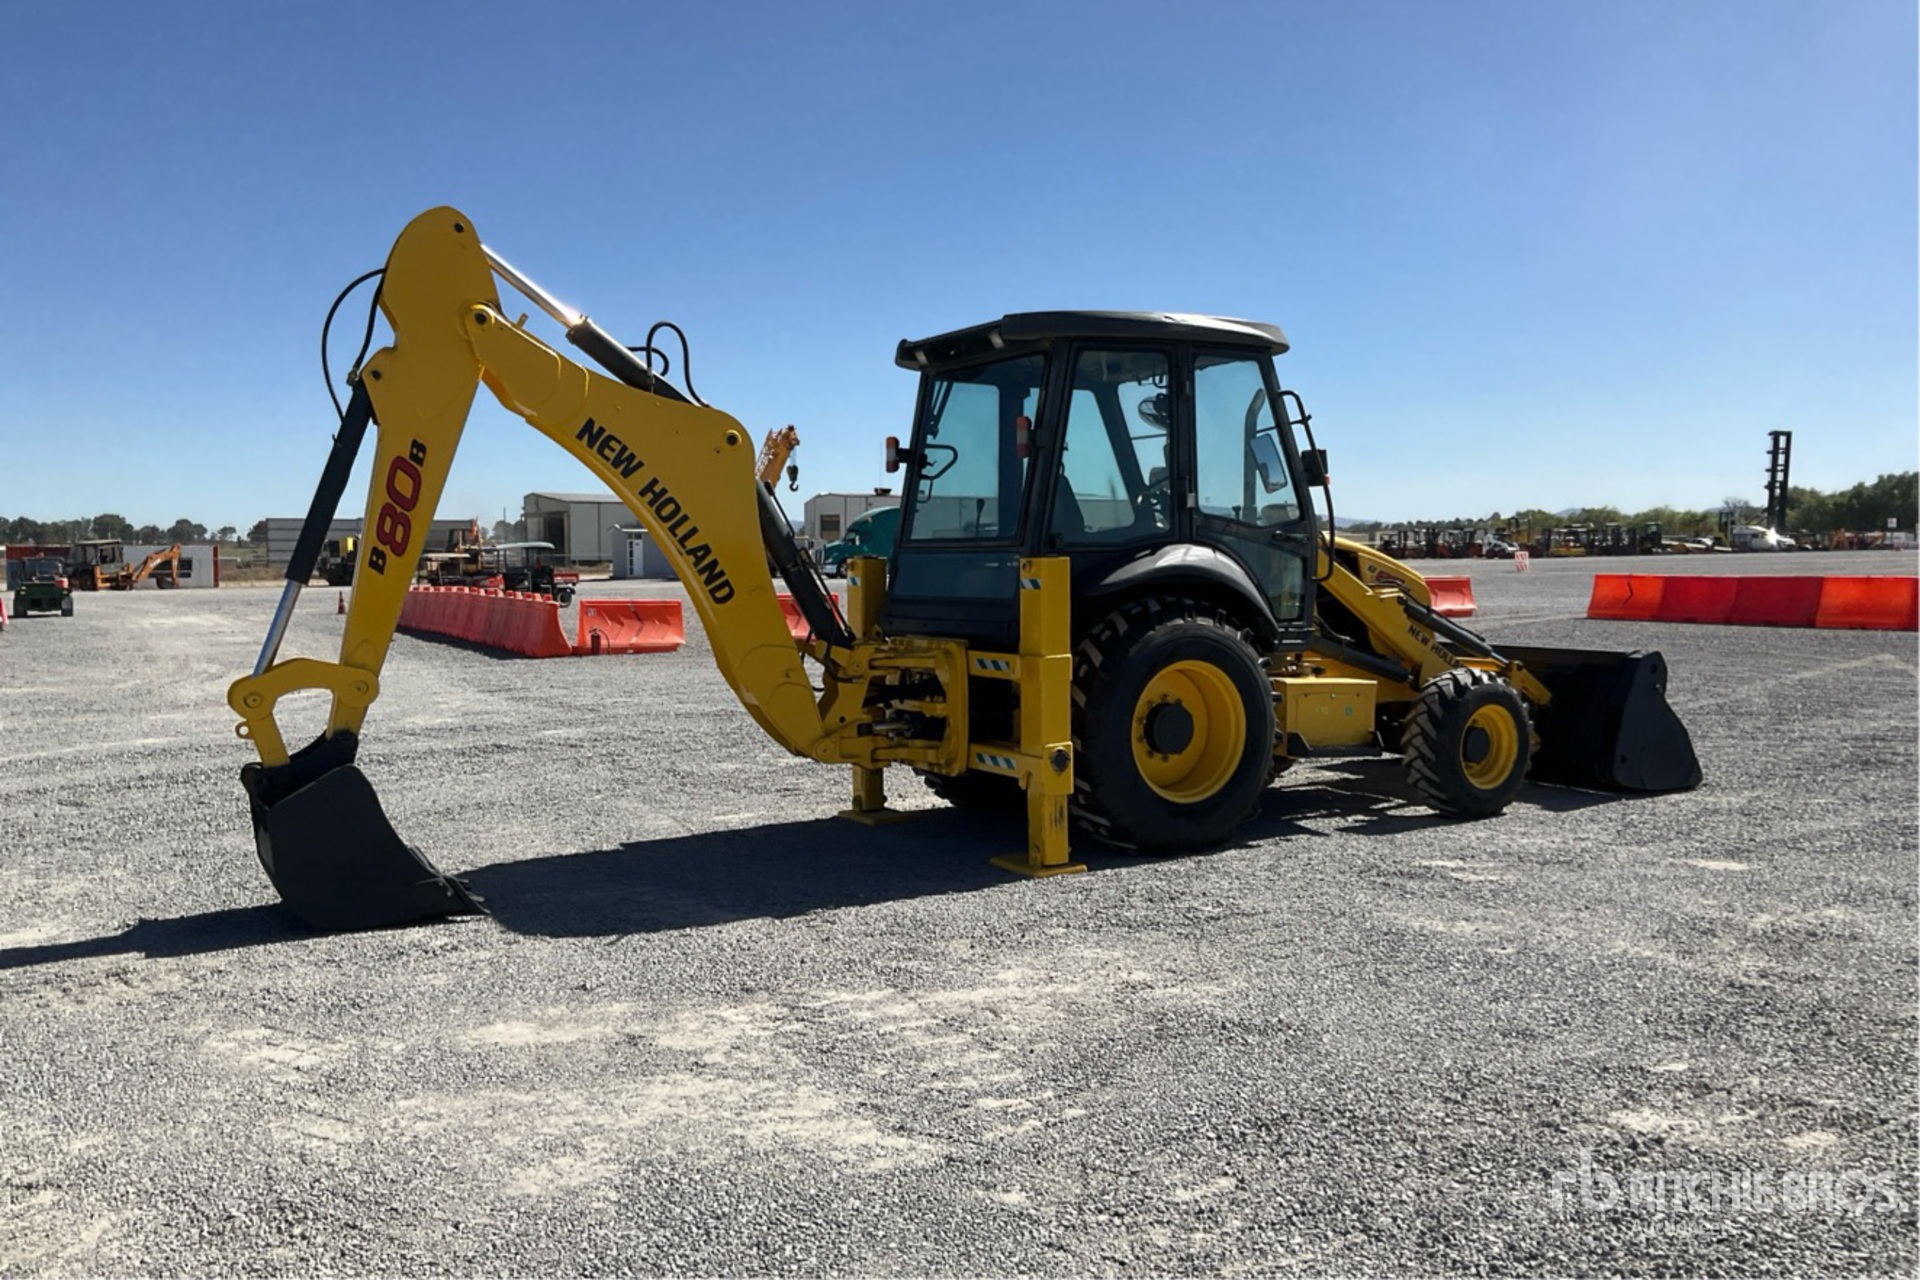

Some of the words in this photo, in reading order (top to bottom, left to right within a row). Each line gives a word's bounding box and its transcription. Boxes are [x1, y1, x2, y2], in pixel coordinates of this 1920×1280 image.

[575, 417, 645, 480] NEW
[638, 477, 735, 605] HOLLAND
[1407, 624, 1431, 647] NEW
